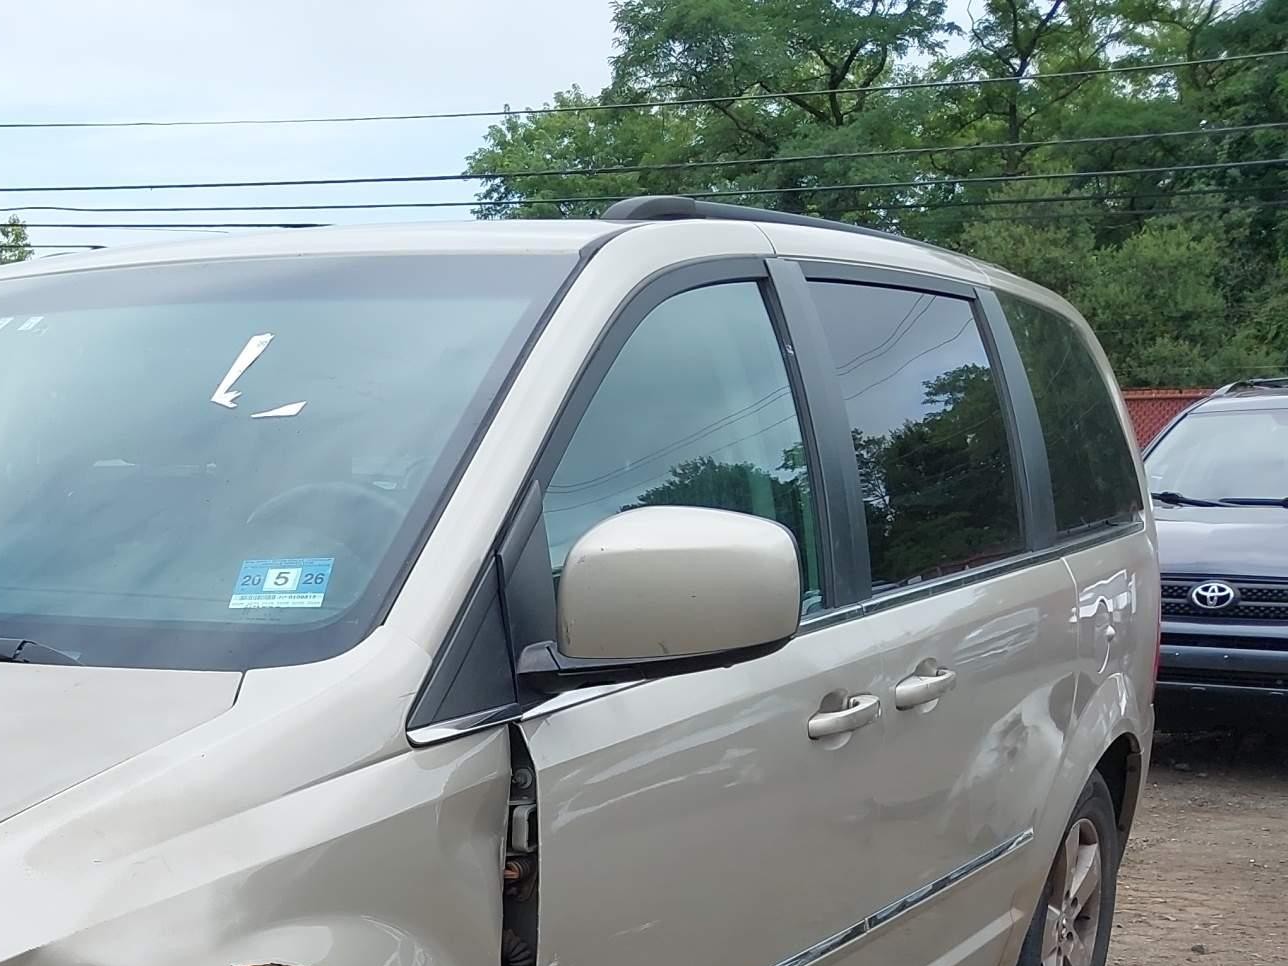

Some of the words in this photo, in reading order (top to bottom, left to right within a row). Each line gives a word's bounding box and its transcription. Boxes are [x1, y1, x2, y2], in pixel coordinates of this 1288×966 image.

[240, 574, 262, 586] 20
[273, 571, 291, 587] 5
[302, 572, 325, 585] 26
